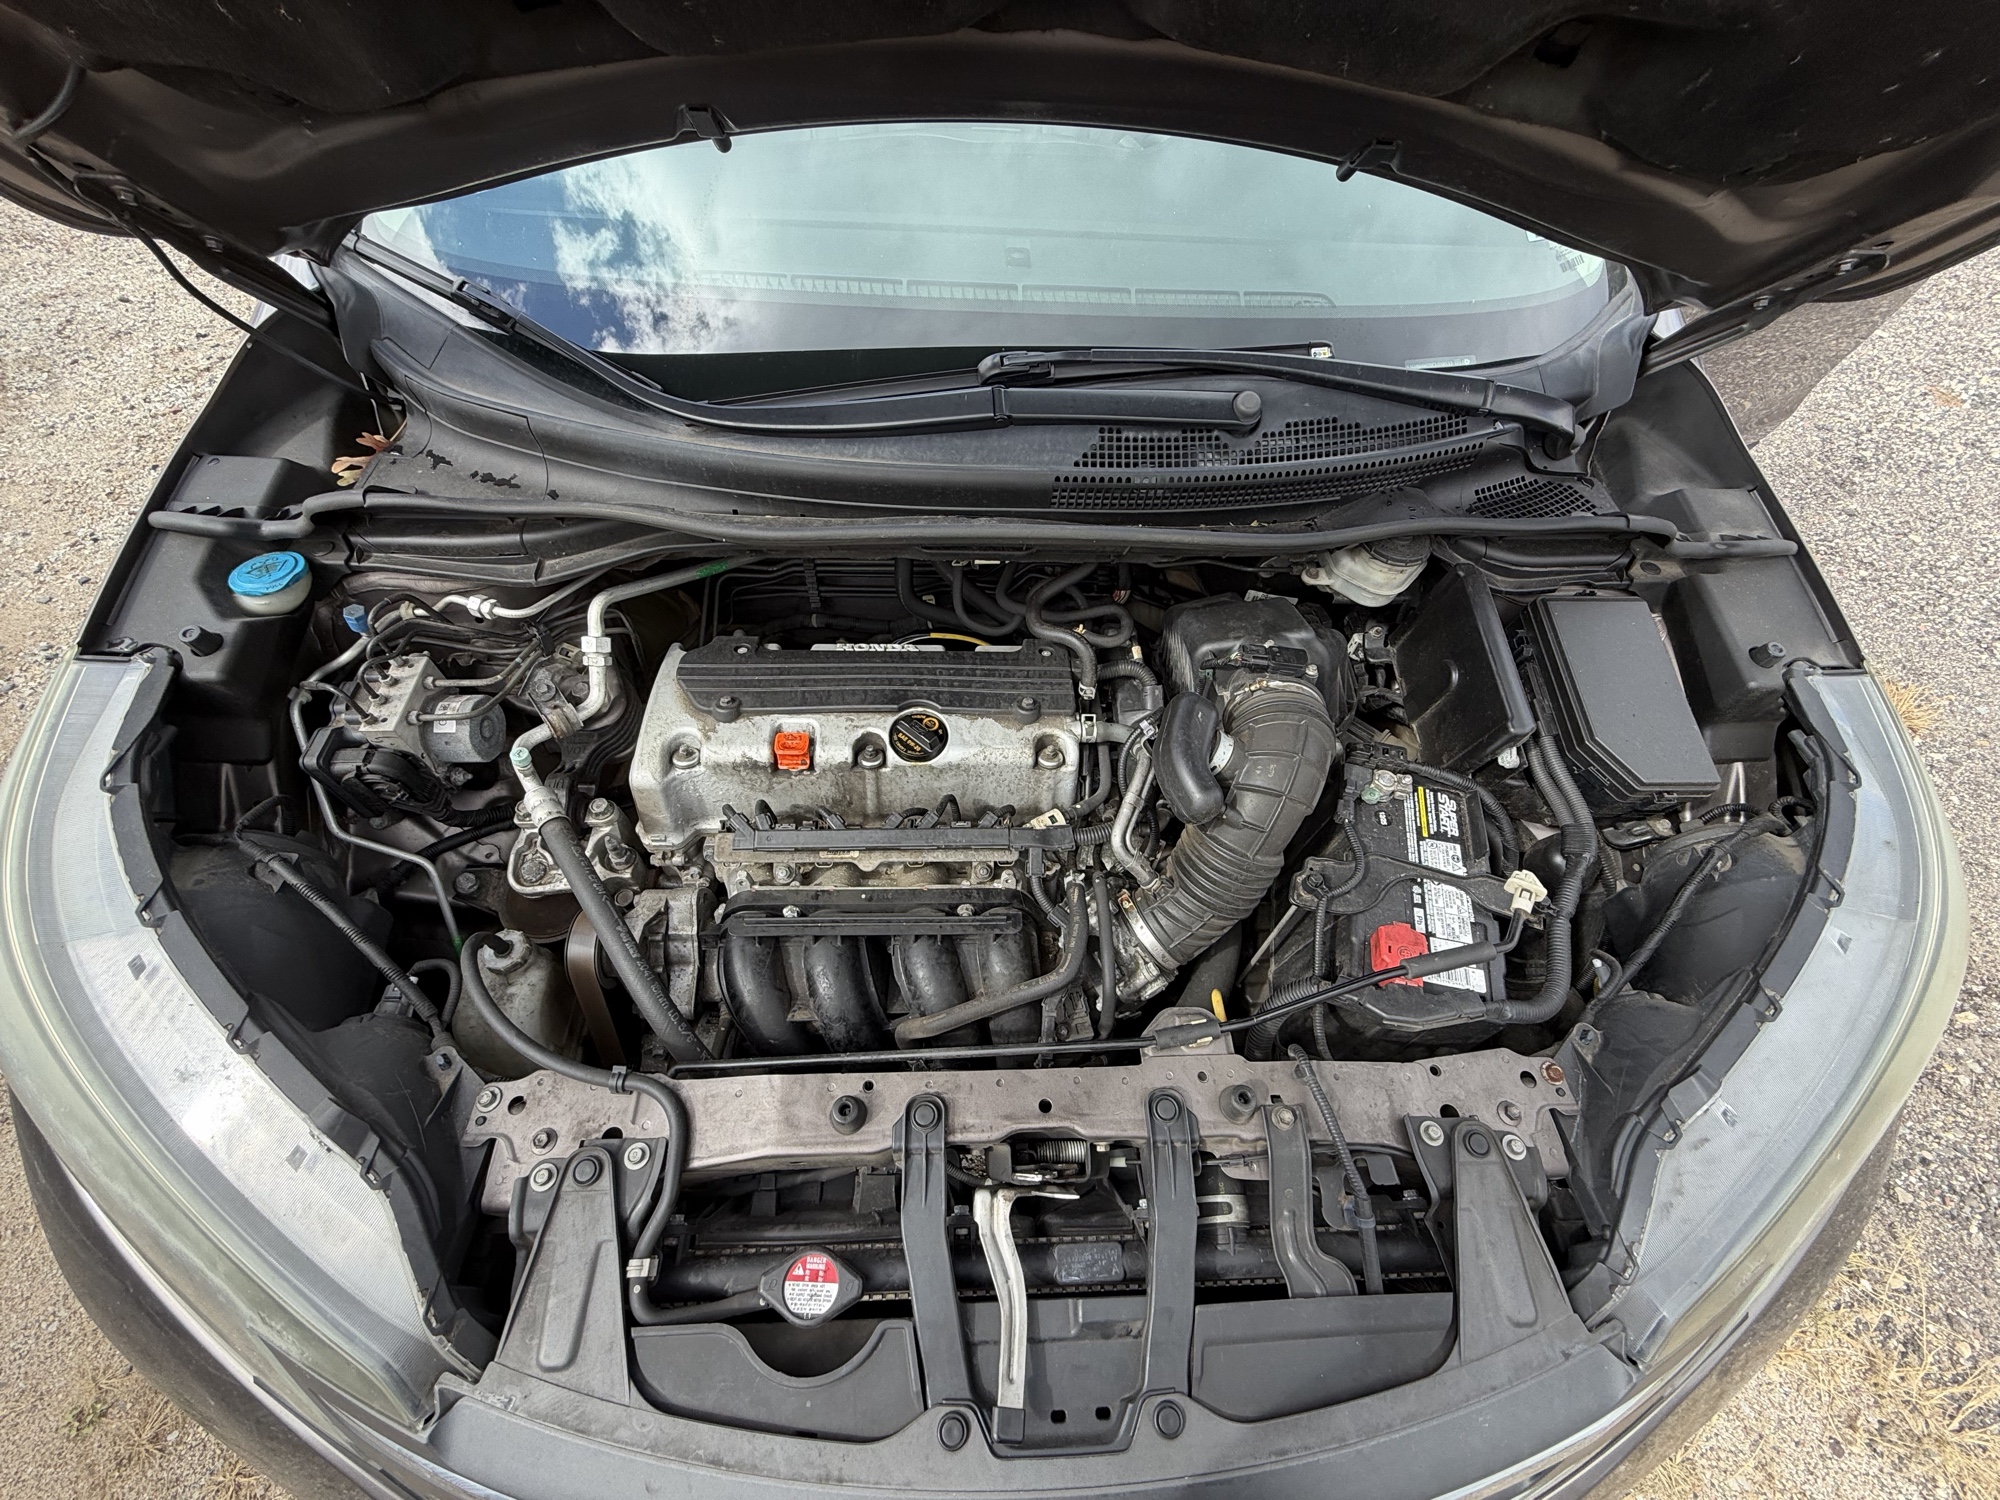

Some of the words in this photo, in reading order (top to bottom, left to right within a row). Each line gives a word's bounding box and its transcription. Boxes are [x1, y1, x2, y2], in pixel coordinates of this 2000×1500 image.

[836, 643, 920, 652] HONDA
[897, 732, 908, 742] SAE
[1438, 792, 1451, 834] START
[1448, 799, 1459, 837] SUPER
[1416, 915, 1423, 926] Pb
[615, 925, 641, 959] Parker
[636, 959, 655, 981] 2041
